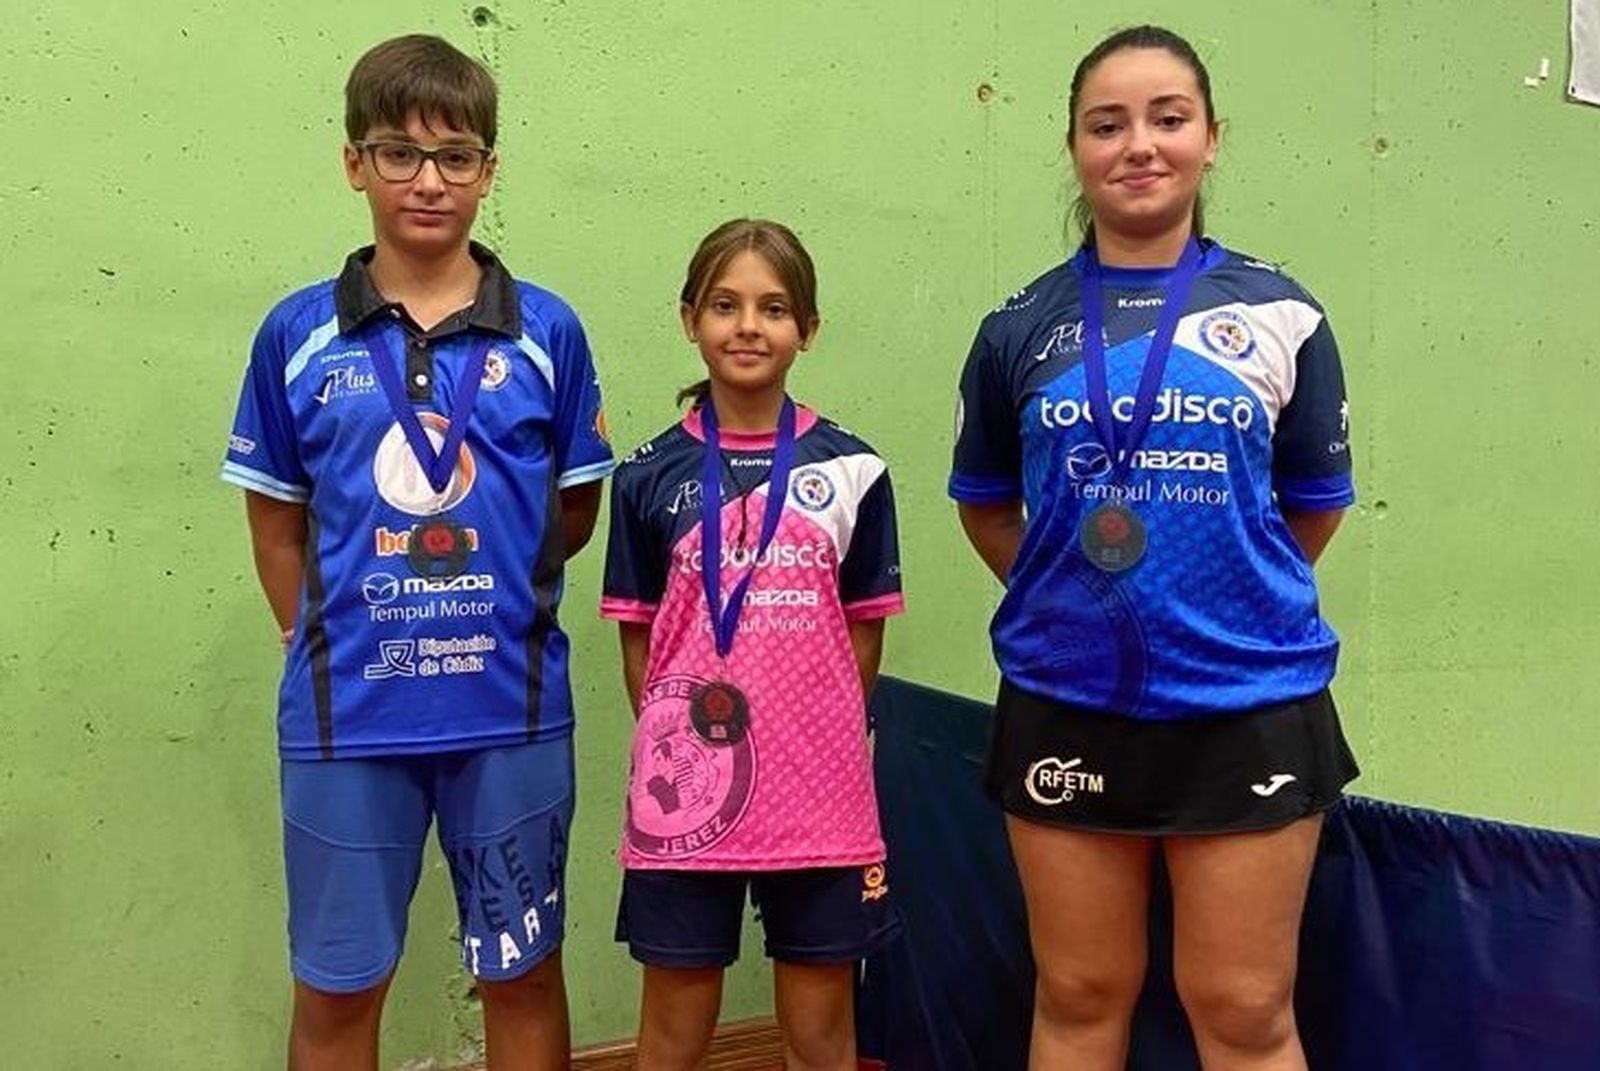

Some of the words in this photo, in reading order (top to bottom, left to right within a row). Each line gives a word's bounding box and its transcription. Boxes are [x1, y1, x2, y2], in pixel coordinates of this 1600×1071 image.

[326, 365, 375, 391] Plus
[1070, 479, 1151, 506] Tempul
[1159, 482, 1230, 505] Motor
[368, 599, 436, 624] Tempul
[440, 599, 496, 618] Motor
[1039, 767, 1105, 793] RFETM
[656, 814, 729, 855] JEREZ
